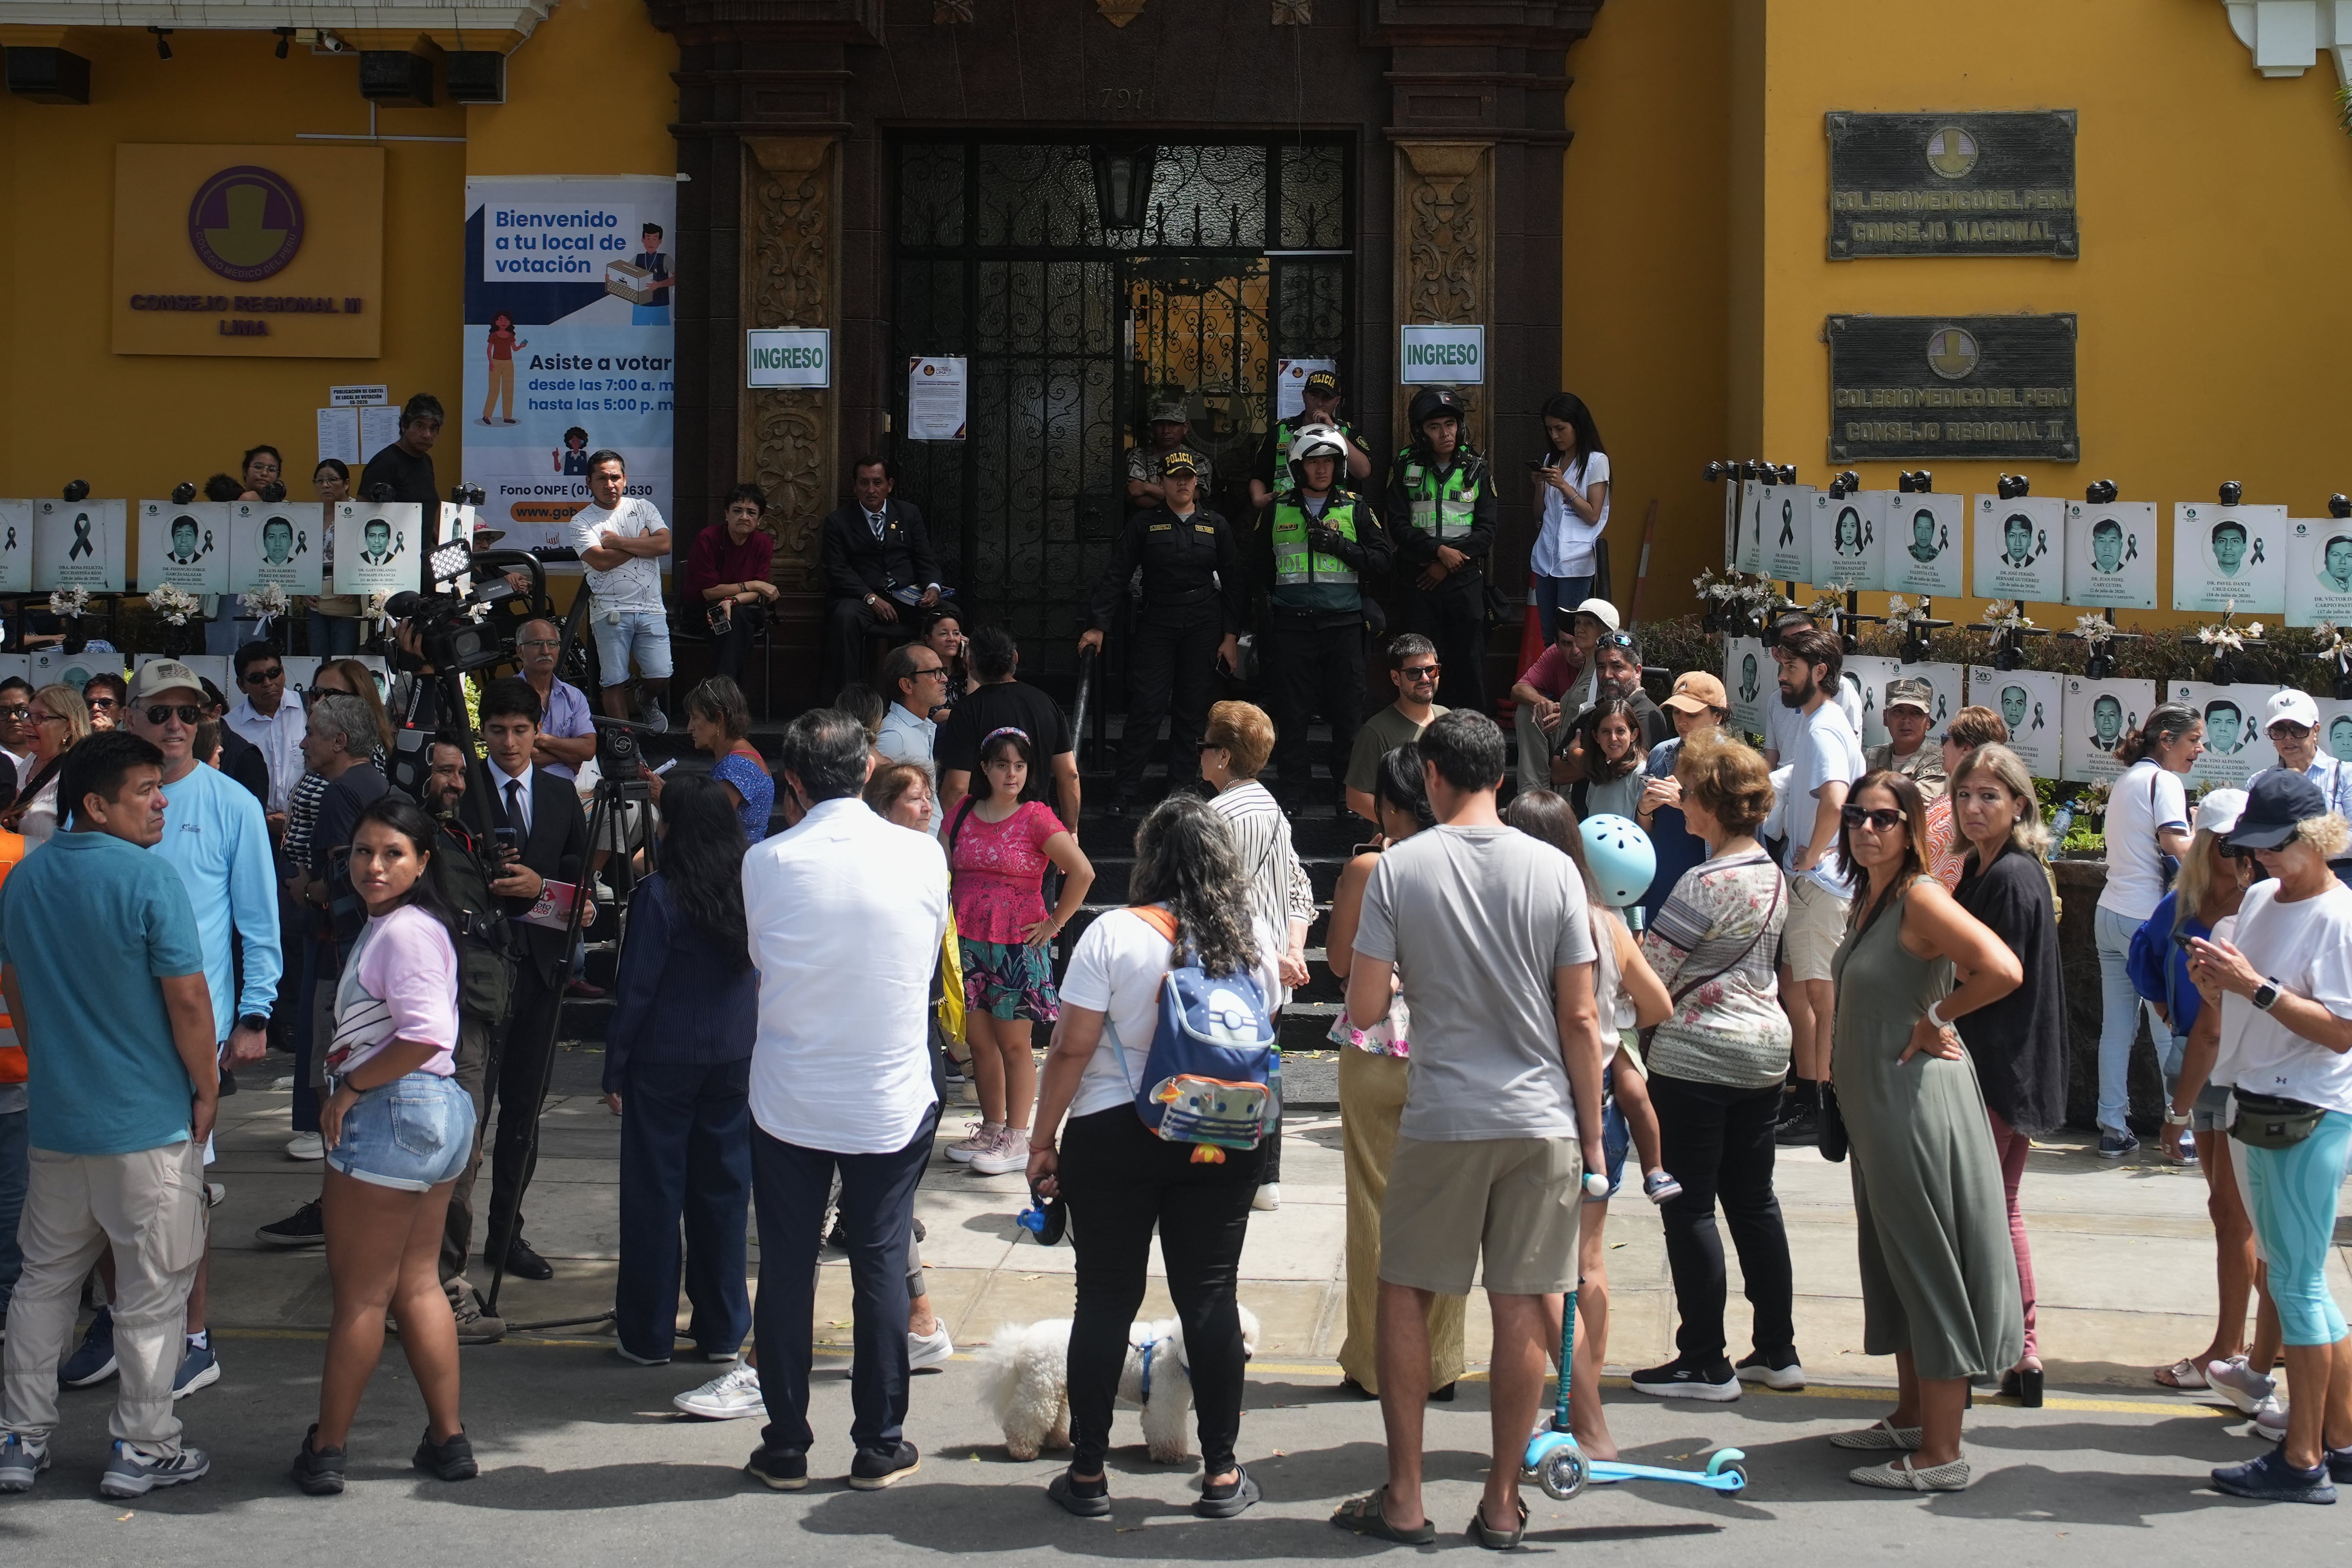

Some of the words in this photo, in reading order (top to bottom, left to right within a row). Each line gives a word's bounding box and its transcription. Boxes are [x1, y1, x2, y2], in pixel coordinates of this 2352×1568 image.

[1101, 88, 1143, 109] 791
[1833, 191, 1913, 210] COLEGIO
[1914, 191, 1984, 210] MEDICO
[1985, 190, 2022, 209] DEL
[2023, 189, 2074, 209] PERU
[496, 209, 617, 227] Bienvenido
[1852, 222, 1946, 242] CONSEJO
[1953, 222, 2055, 242] NACIONAL
[496, 237, 508, 250] a
[515, 234, 536, 250] tu
[543, 234, 594, 250] local
[600, 234, 626, 250] de
[196, 231, 224, 270] COLEGIO
[224, 266, 262, 278] MEDICO
[264, 262, 282, 273] DEL
[281, 233, 296, 260] PERU
[495, 255, 591, 272] votación
[130, 294, 228, 312] CONSEJO
[234, 296, 339, 313] REGIONAL
[345, 297, 361, 313] III
[220, 320, 269, 336] LIMA
[530, 353, 593, 370] Asiste
[598, 358, 610, 370] a
[616, 356, 672, 371] votar
[754, 347, 824, 369] INGRESO
[1407, 344, 1478, 365] INGRESO
[529, 379, 575, 391] desde
[579, 379, 602, 391] las
[606, 379, 637, 391] 7:00
[641, 382, 655, 391] a.
[1309, 374, 1335, 389] POLICIA
[529, 398, 573, 410] hasta
[577, 398, 599, 410] las
[604, 399, 636, 410] 5:00
[640, 401, 654, 414] p.
[1835, 389, 1915, 408] COLEGIO
[1915, 389, 1985, 408] MEDICO
[1986, 389, 2023, 408] DEL
[2023, 389, 2073, 407] PERU
[1846, 423, 1940, 441] CONSEJO
[1946, 422, 2043, 441] REGIONAL
[2047, 421, 2063, 440] III
[1165, 452, 1194, 467] POLICIA
[500, 485, 531, 495] Fono
[534, 485, 568, 495] ONPE
[516, 507, 579, 519] www.gob
[536, 902, 552, 910] oto
